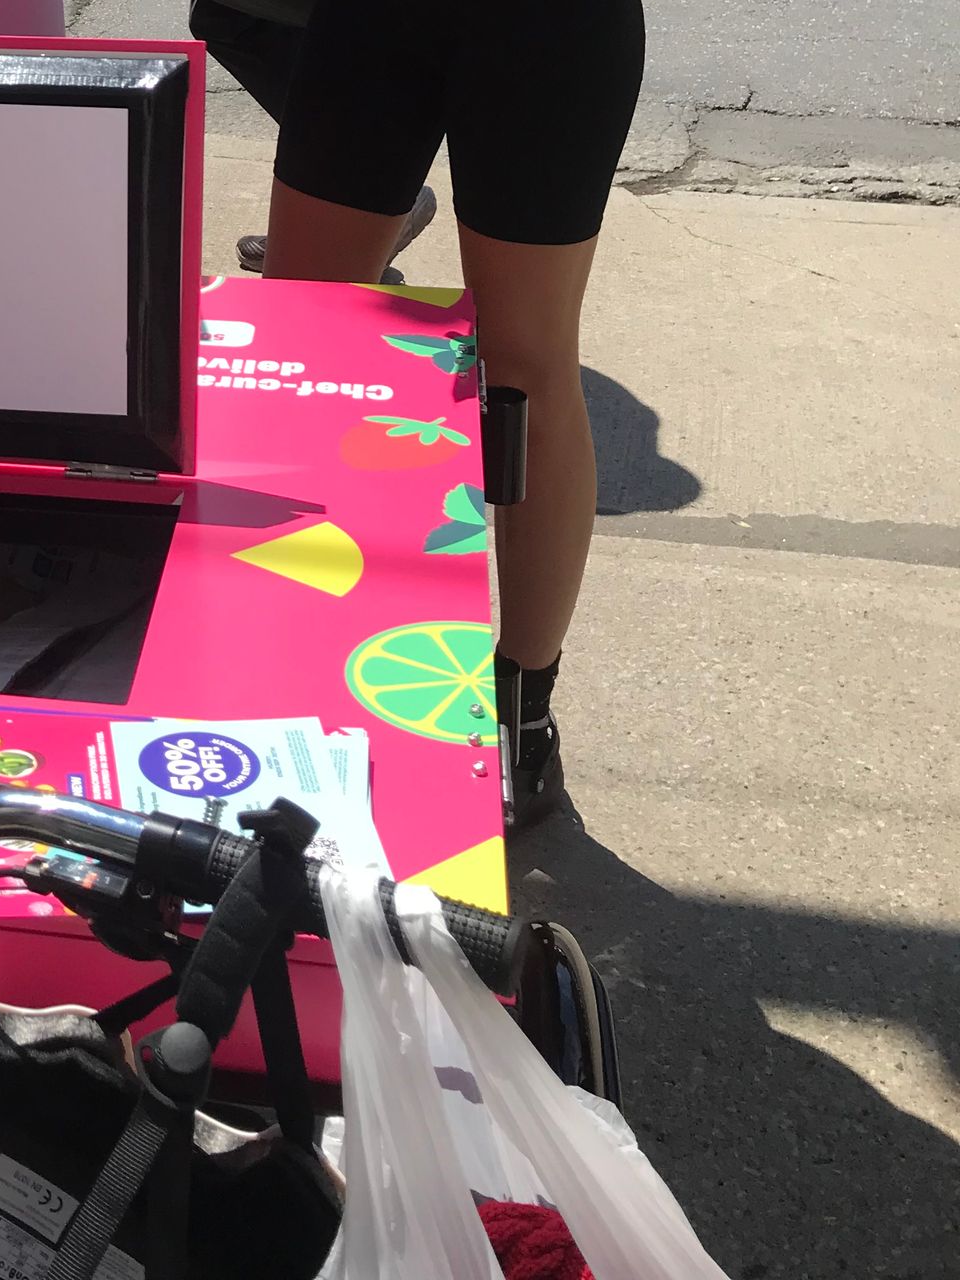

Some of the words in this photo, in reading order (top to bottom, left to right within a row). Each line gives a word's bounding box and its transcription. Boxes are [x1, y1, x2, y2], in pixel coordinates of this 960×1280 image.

[162, 738, 204, 791] 50%
[198, 746, 227, 783] OFF!
[222, 773, 248, 790] YOUR
[240, 753, 251, 775] ENTIRE
